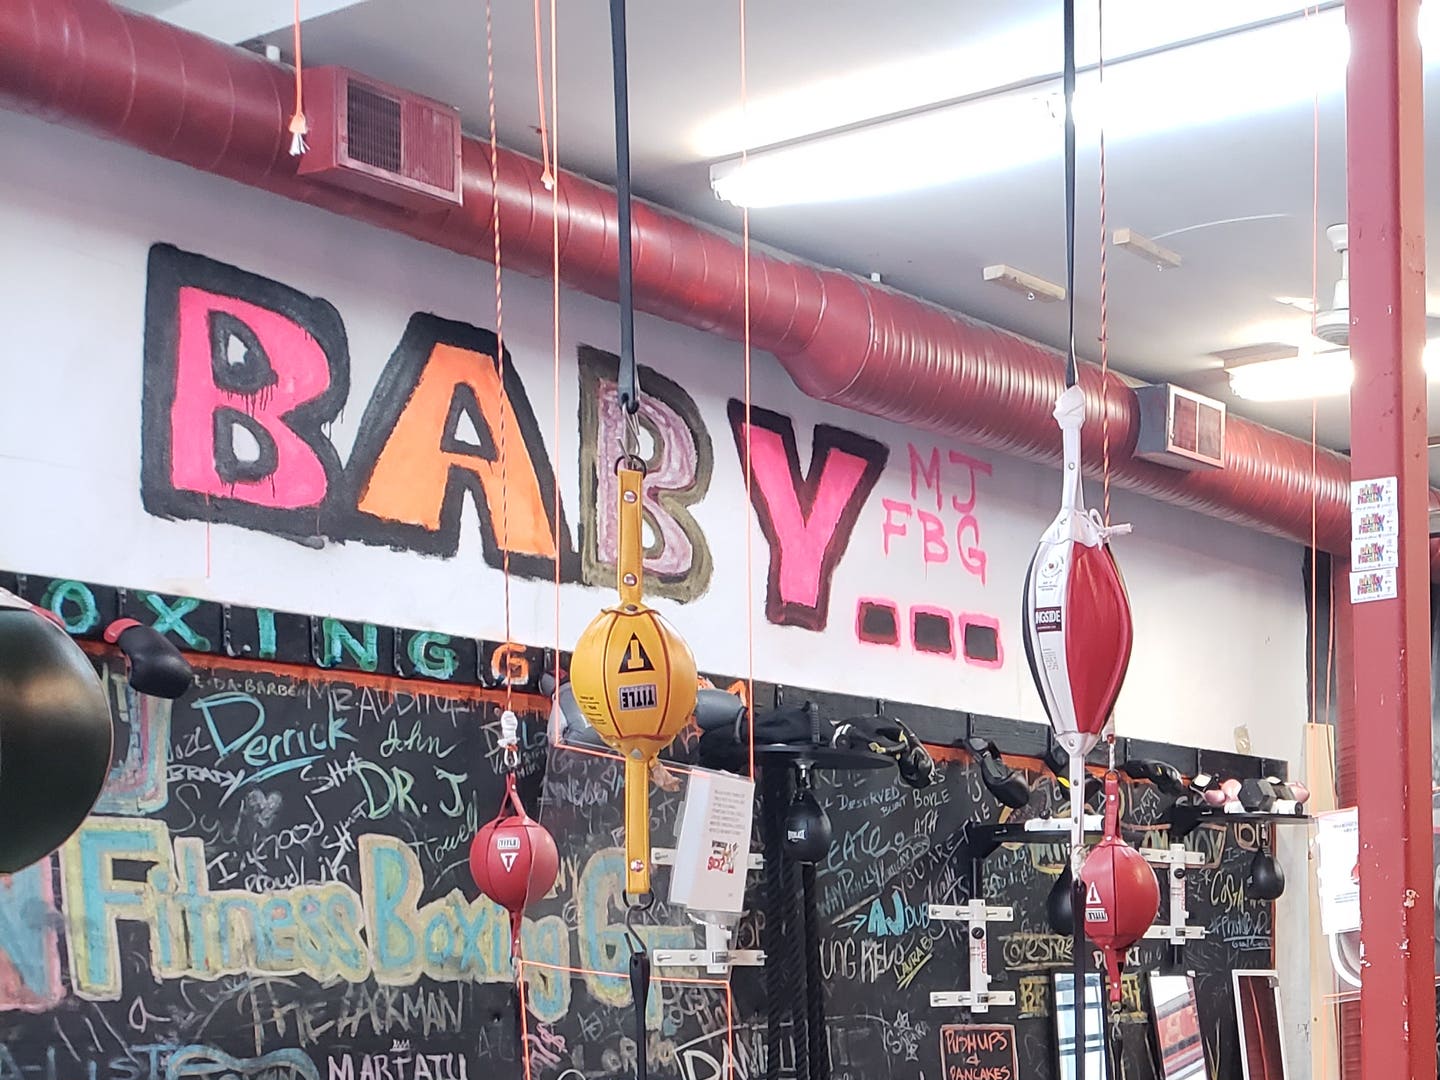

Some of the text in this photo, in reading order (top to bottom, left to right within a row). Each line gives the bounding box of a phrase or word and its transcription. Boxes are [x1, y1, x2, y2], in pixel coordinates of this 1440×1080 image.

[908, 440, 993, 518] MJ
[881, 501, 988, 587] FBG
[191, 691, 360, 766] Derrick
[621, 687, 655, 709] TITLE
[70, 815, 367, 1001] Fitness
